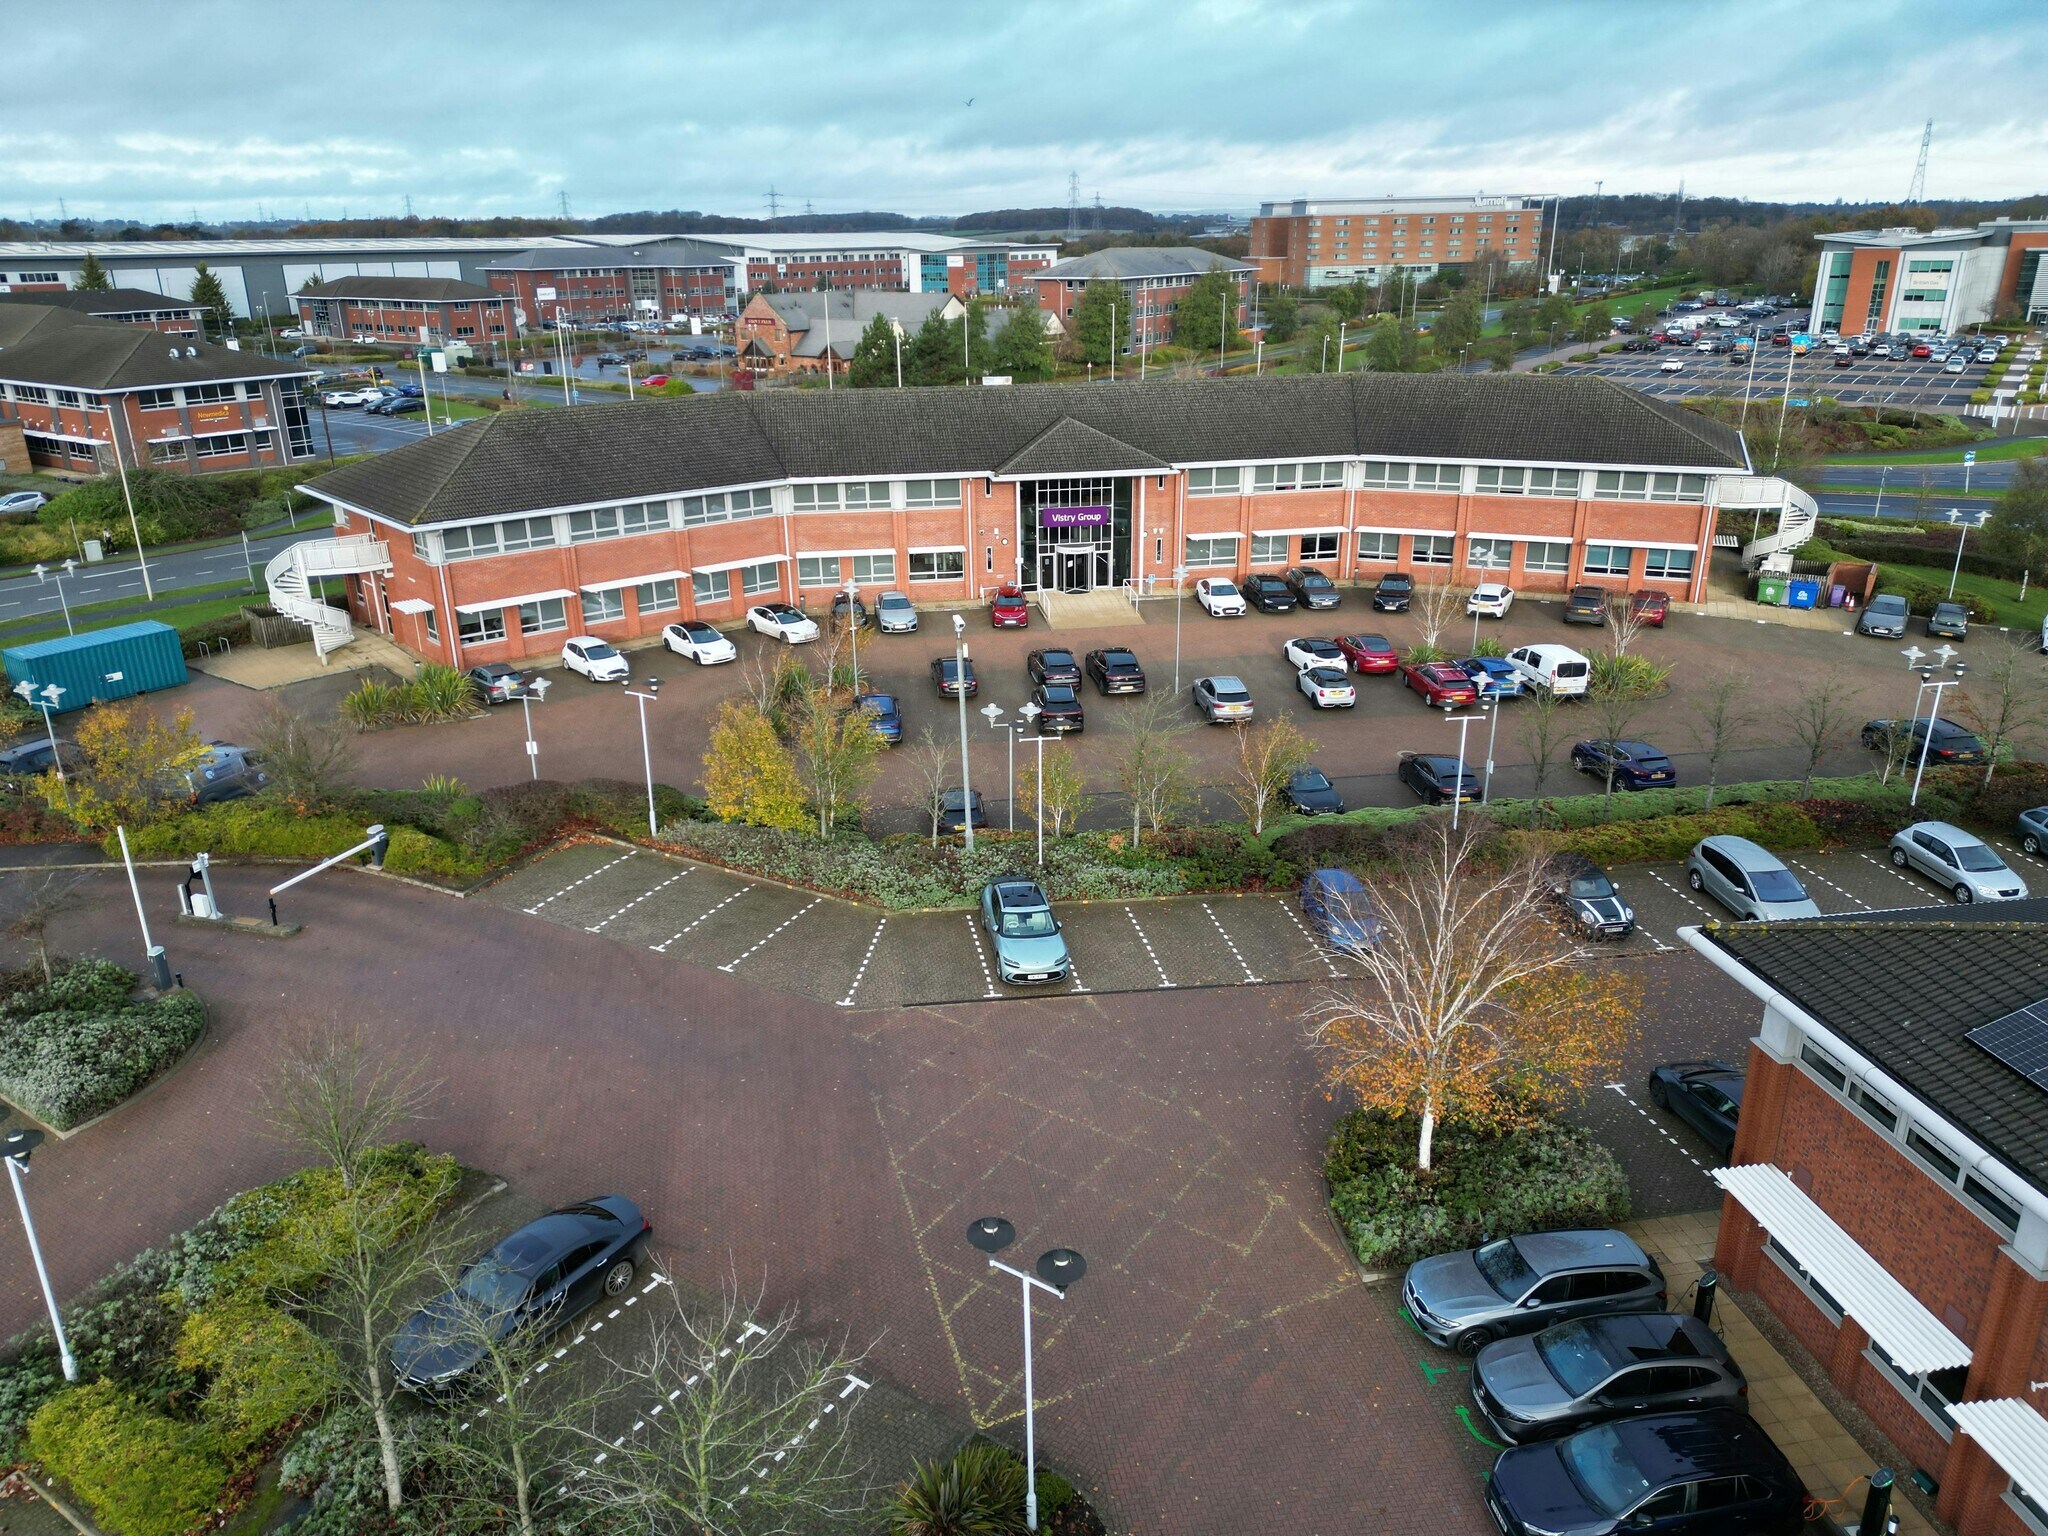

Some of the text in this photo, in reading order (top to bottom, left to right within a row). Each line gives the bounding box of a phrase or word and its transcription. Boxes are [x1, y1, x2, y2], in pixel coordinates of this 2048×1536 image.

[197, 410, 229, 419] Newmedica
[1052, 513, 1101, 523] Vistry Group
